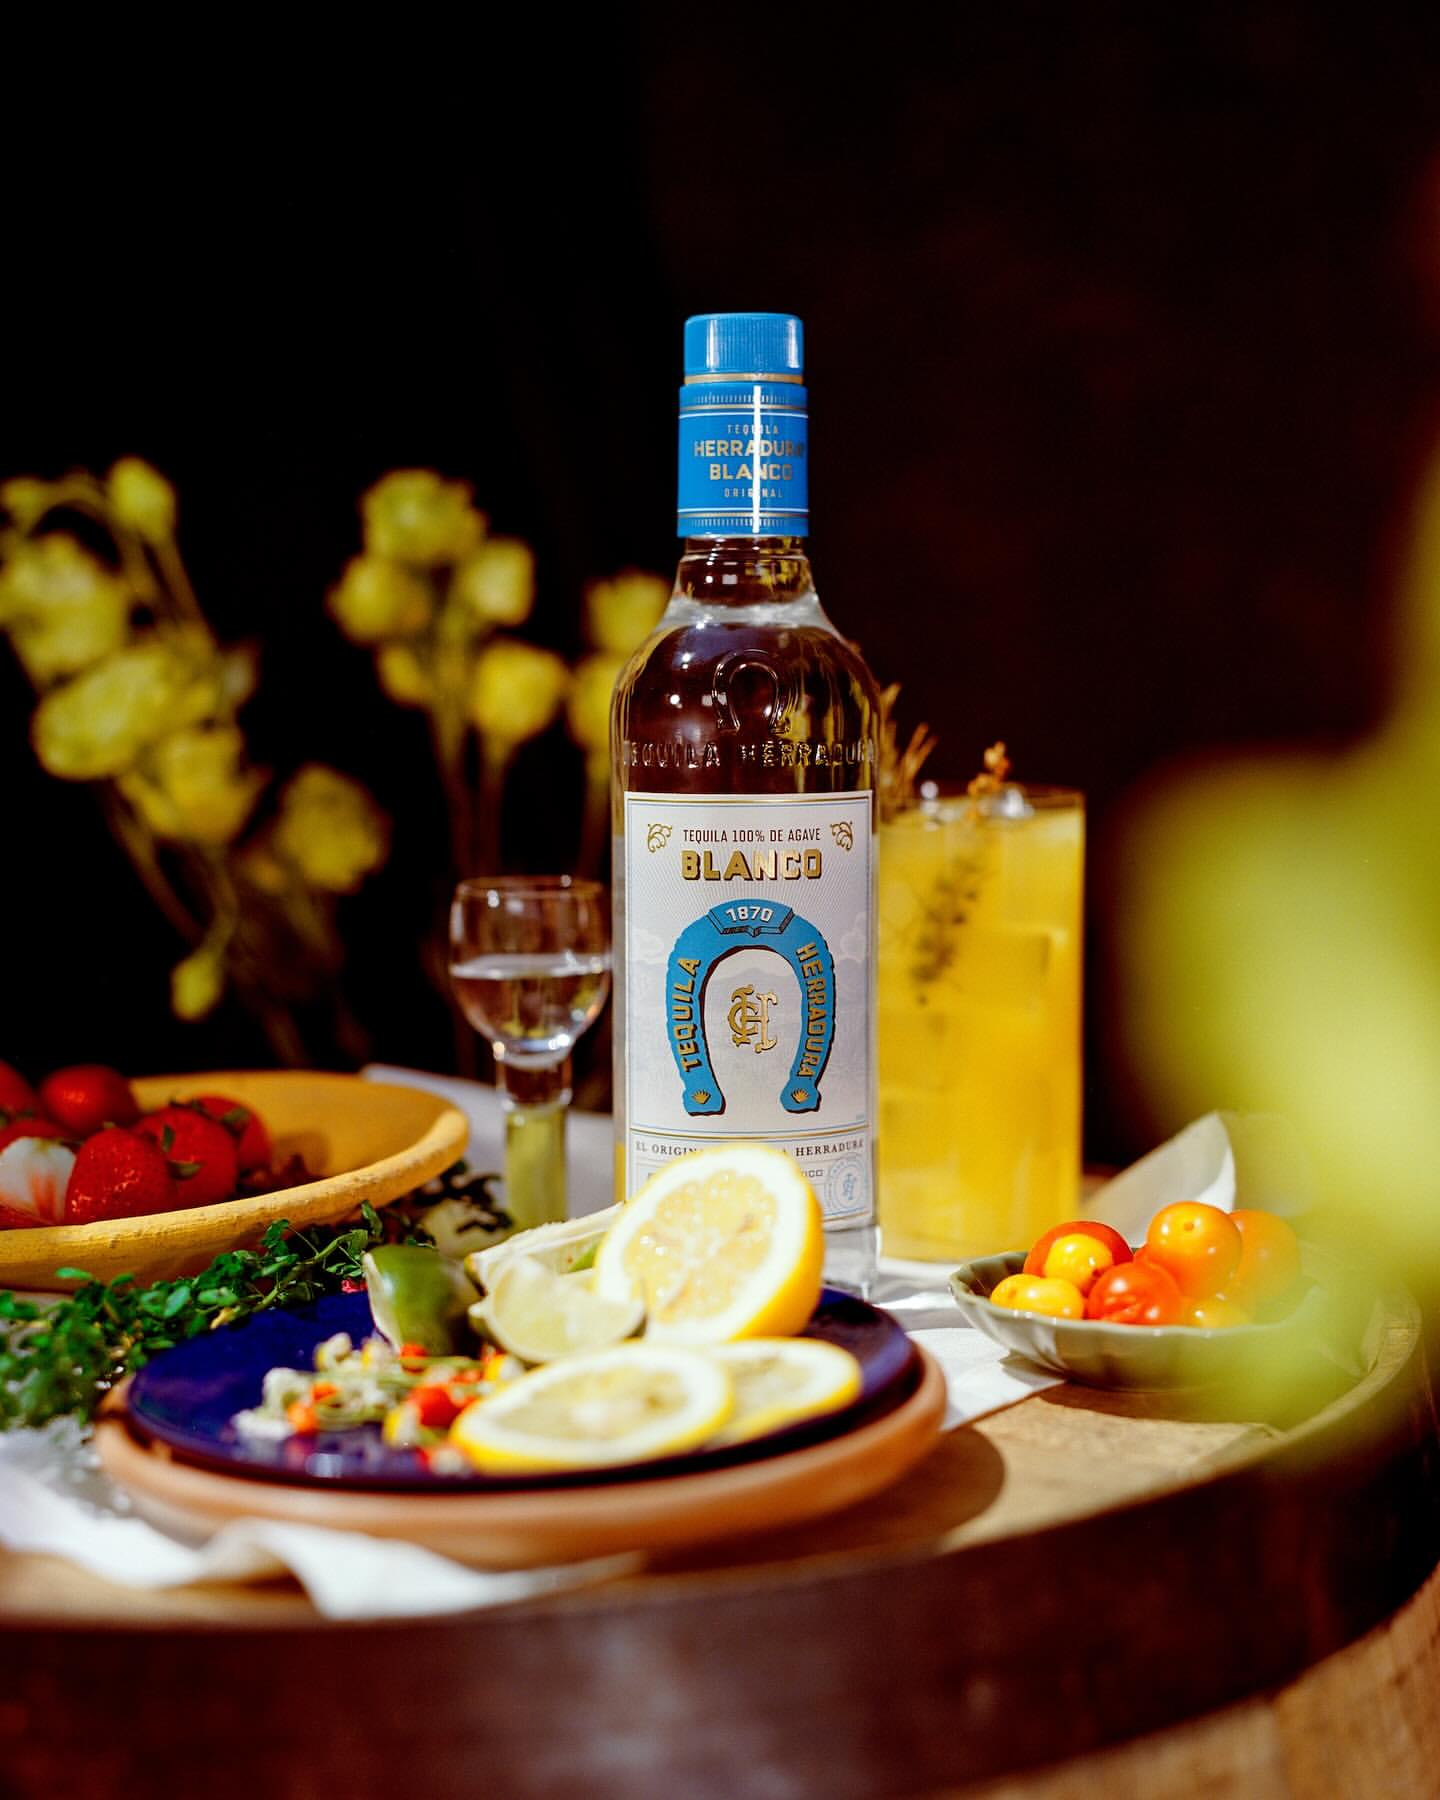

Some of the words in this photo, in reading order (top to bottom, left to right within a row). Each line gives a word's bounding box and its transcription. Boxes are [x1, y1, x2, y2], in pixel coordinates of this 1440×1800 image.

[709, 463, 792, 480] BLANCO
[724, 488, 783, 498] ORIGNAL
[683, 829, 728, 845] TEQUILA
[732, 829, 765, 842] 100%
[769, 829, 784, 842] DE
[788, 828, 821, 841] AGAVE
[680, 849, 823, 881] BLANCO
[726, 906, 774, 922] 1870
[671, 957, 702, 1073] TEQUILA
[796, 941, 826, 1079] HERRADURA
[636, 1141, 648, 1153] EL
[796, 1139, 864, 1157] HERRADURA
